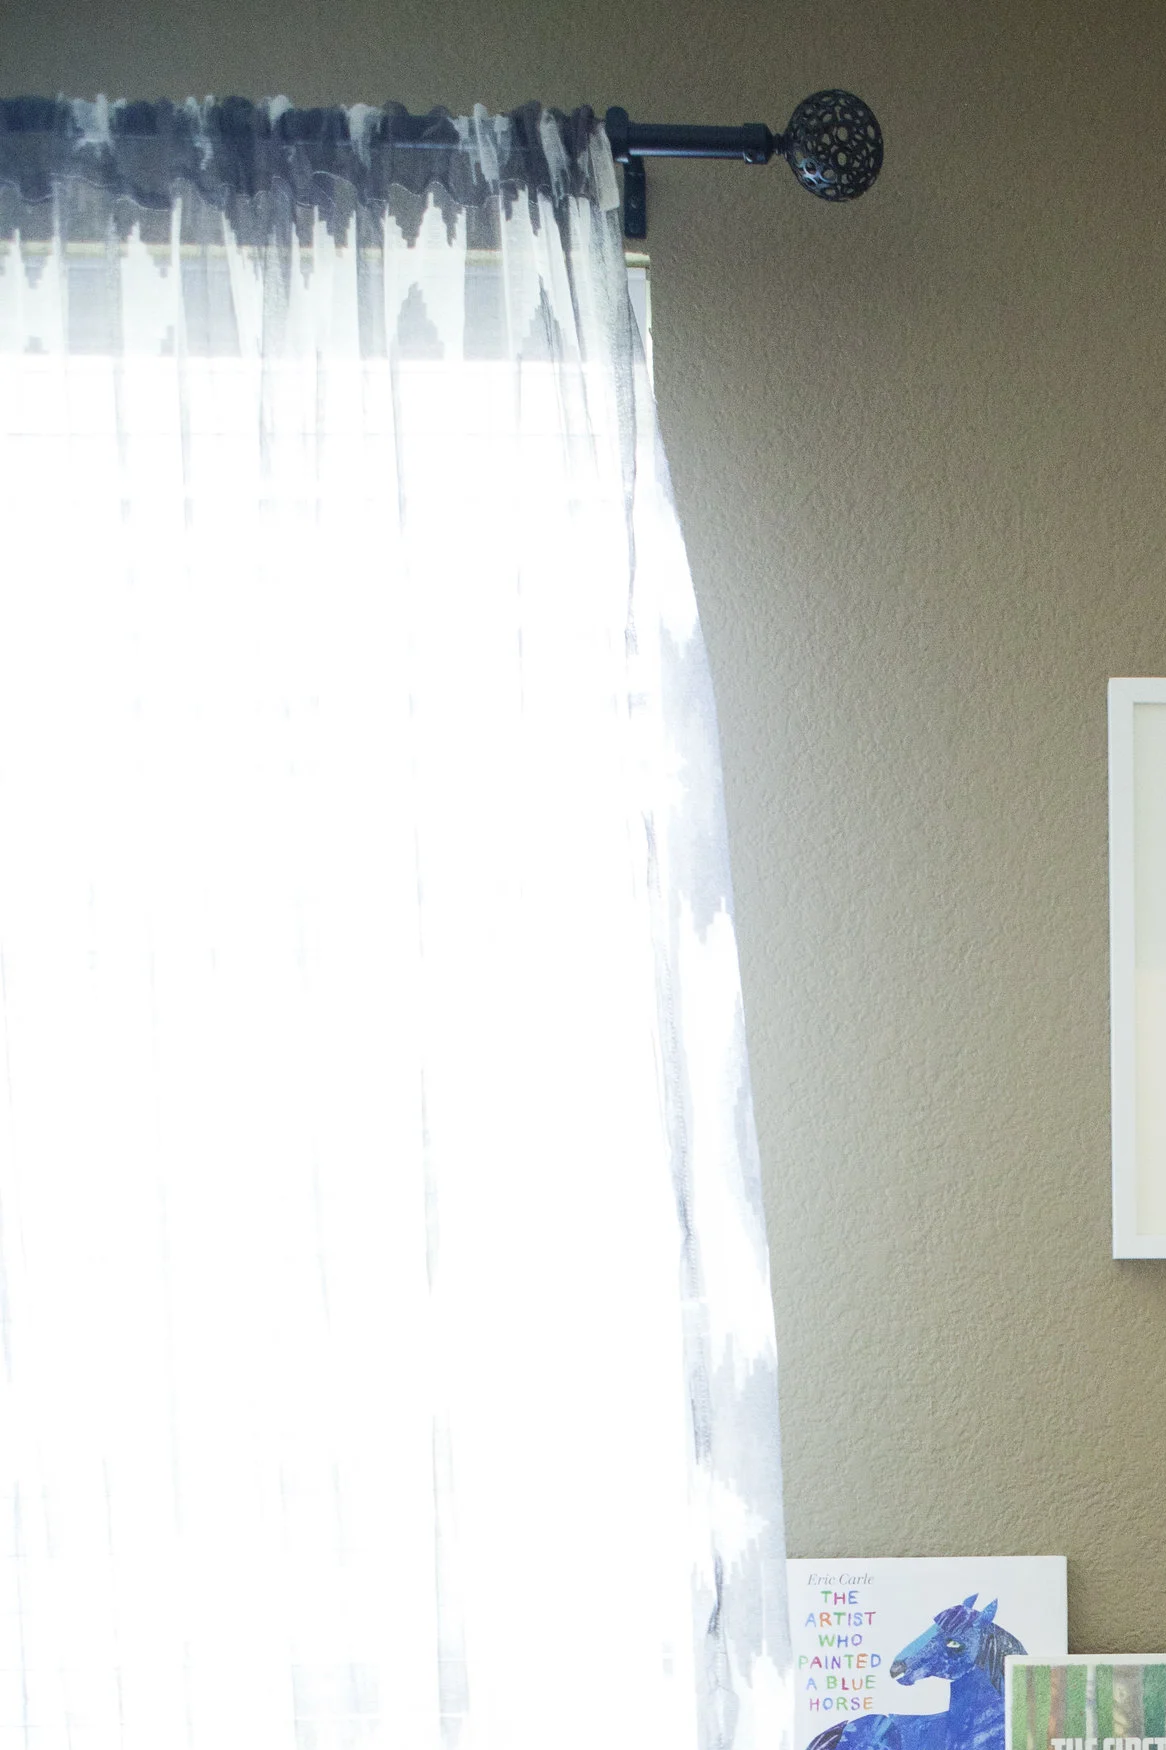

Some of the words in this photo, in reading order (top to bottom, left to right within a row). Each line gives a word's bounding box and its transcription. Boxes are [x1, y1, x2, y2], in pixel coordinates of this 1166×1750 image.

[807, 1573, 836, 1586] Eric
[839, 1573, 874, 1586] Carle
[820, 1590, 859, 1605] THE
[805, 1611, 876, 1628] ARTIST
[818, 1633, 863, 1648] WHO
[799, 1653, 881, 1670] PAINTED
[806, 1677, 817, 1691] A
[827, 1675, 876, 1691] BLUE
[809, 1696, 873, 1712] HORSE
